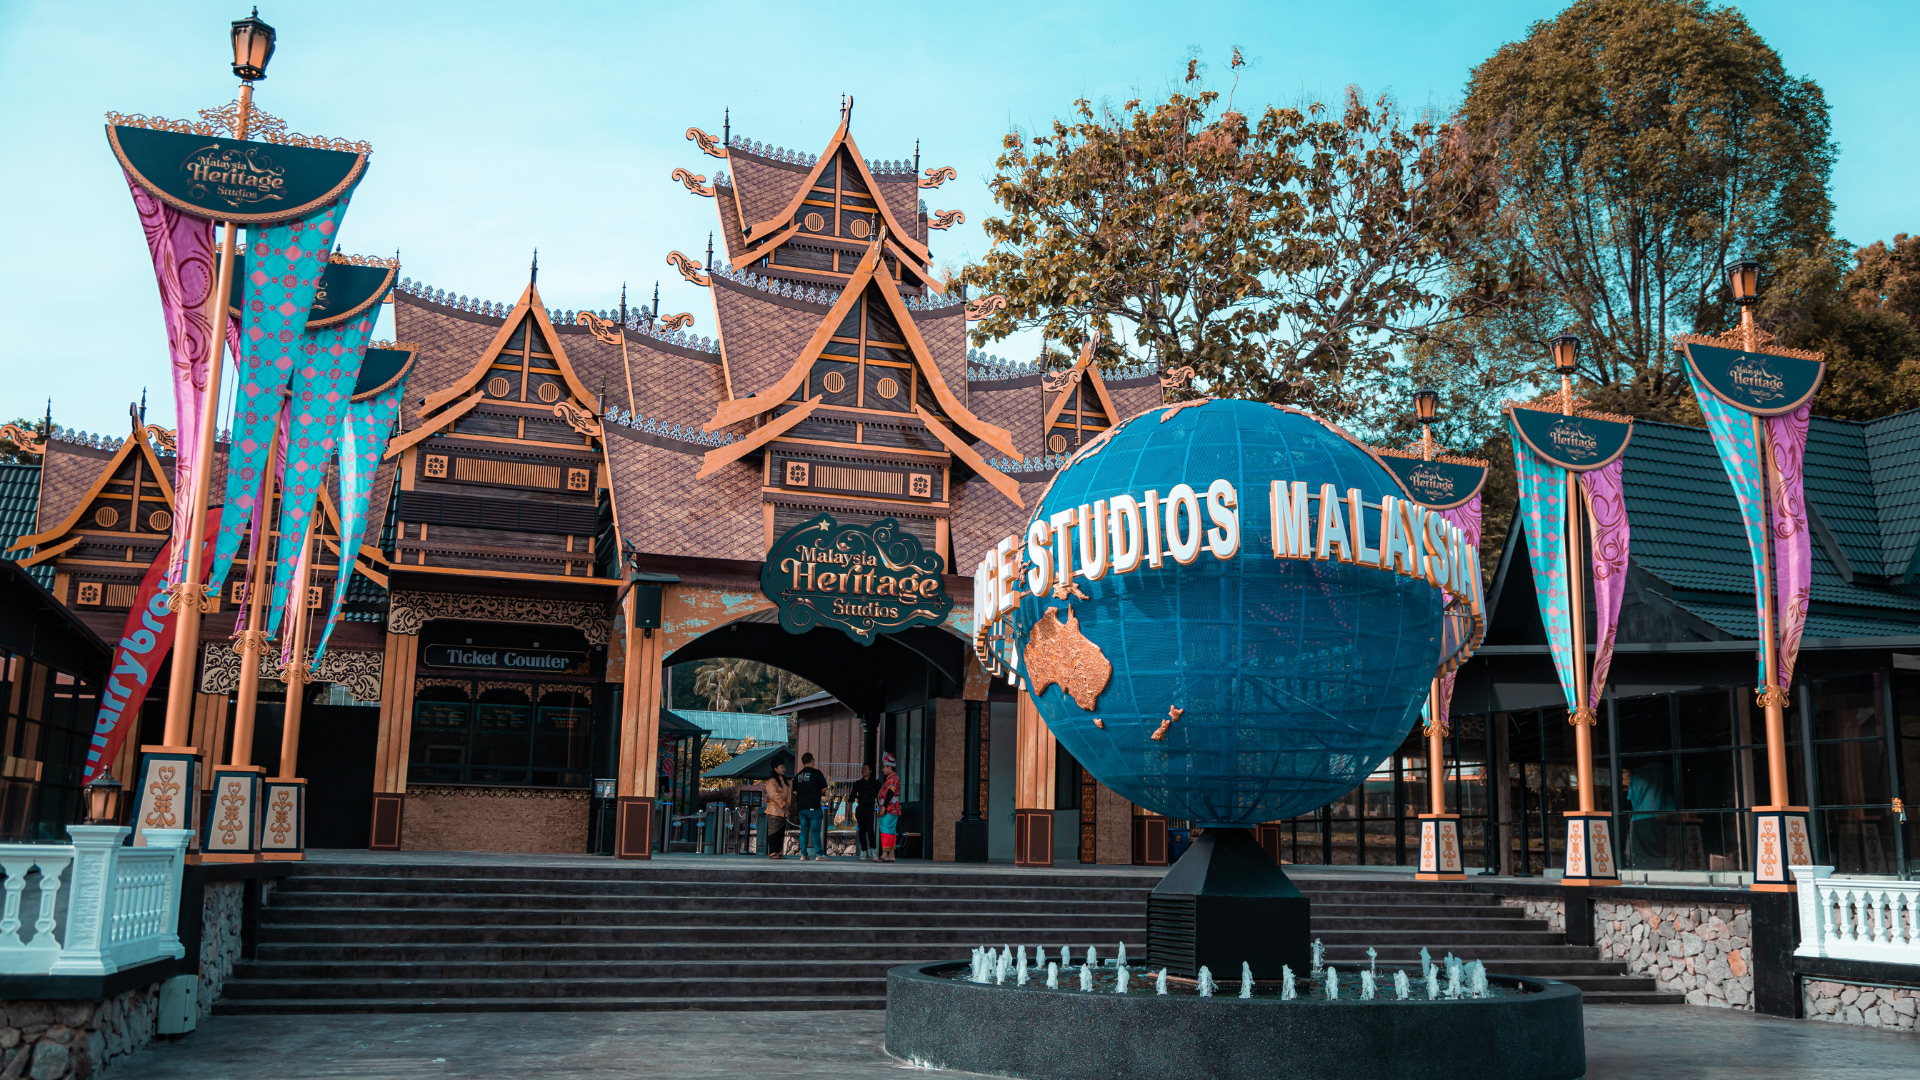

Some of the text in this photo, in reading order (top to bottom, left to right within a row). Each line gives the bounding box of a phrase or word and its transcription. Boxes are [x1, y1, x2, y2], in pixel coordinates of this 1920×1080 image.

[197, 156, 247, 170] Malaysia
[187, 162, 284, 192] Heritage
[217, 185, 257, 199] Studios
[1729, 370, 1784, 392] Heritage
[1550, 431, 1597, 450] Heritage
[1409, 475, 1454, 492] Heritage
[1028, 479, 1239, 597] STUDIOS
[1270, 480, 1475, 604] MALAYSIA
[795, 544, 878, 568] Malaysia
[780, 557, 939, 606] Heritage
[833, 598, 899, 619] Studios
[446, 649, 570, 669] Ticket Counter
